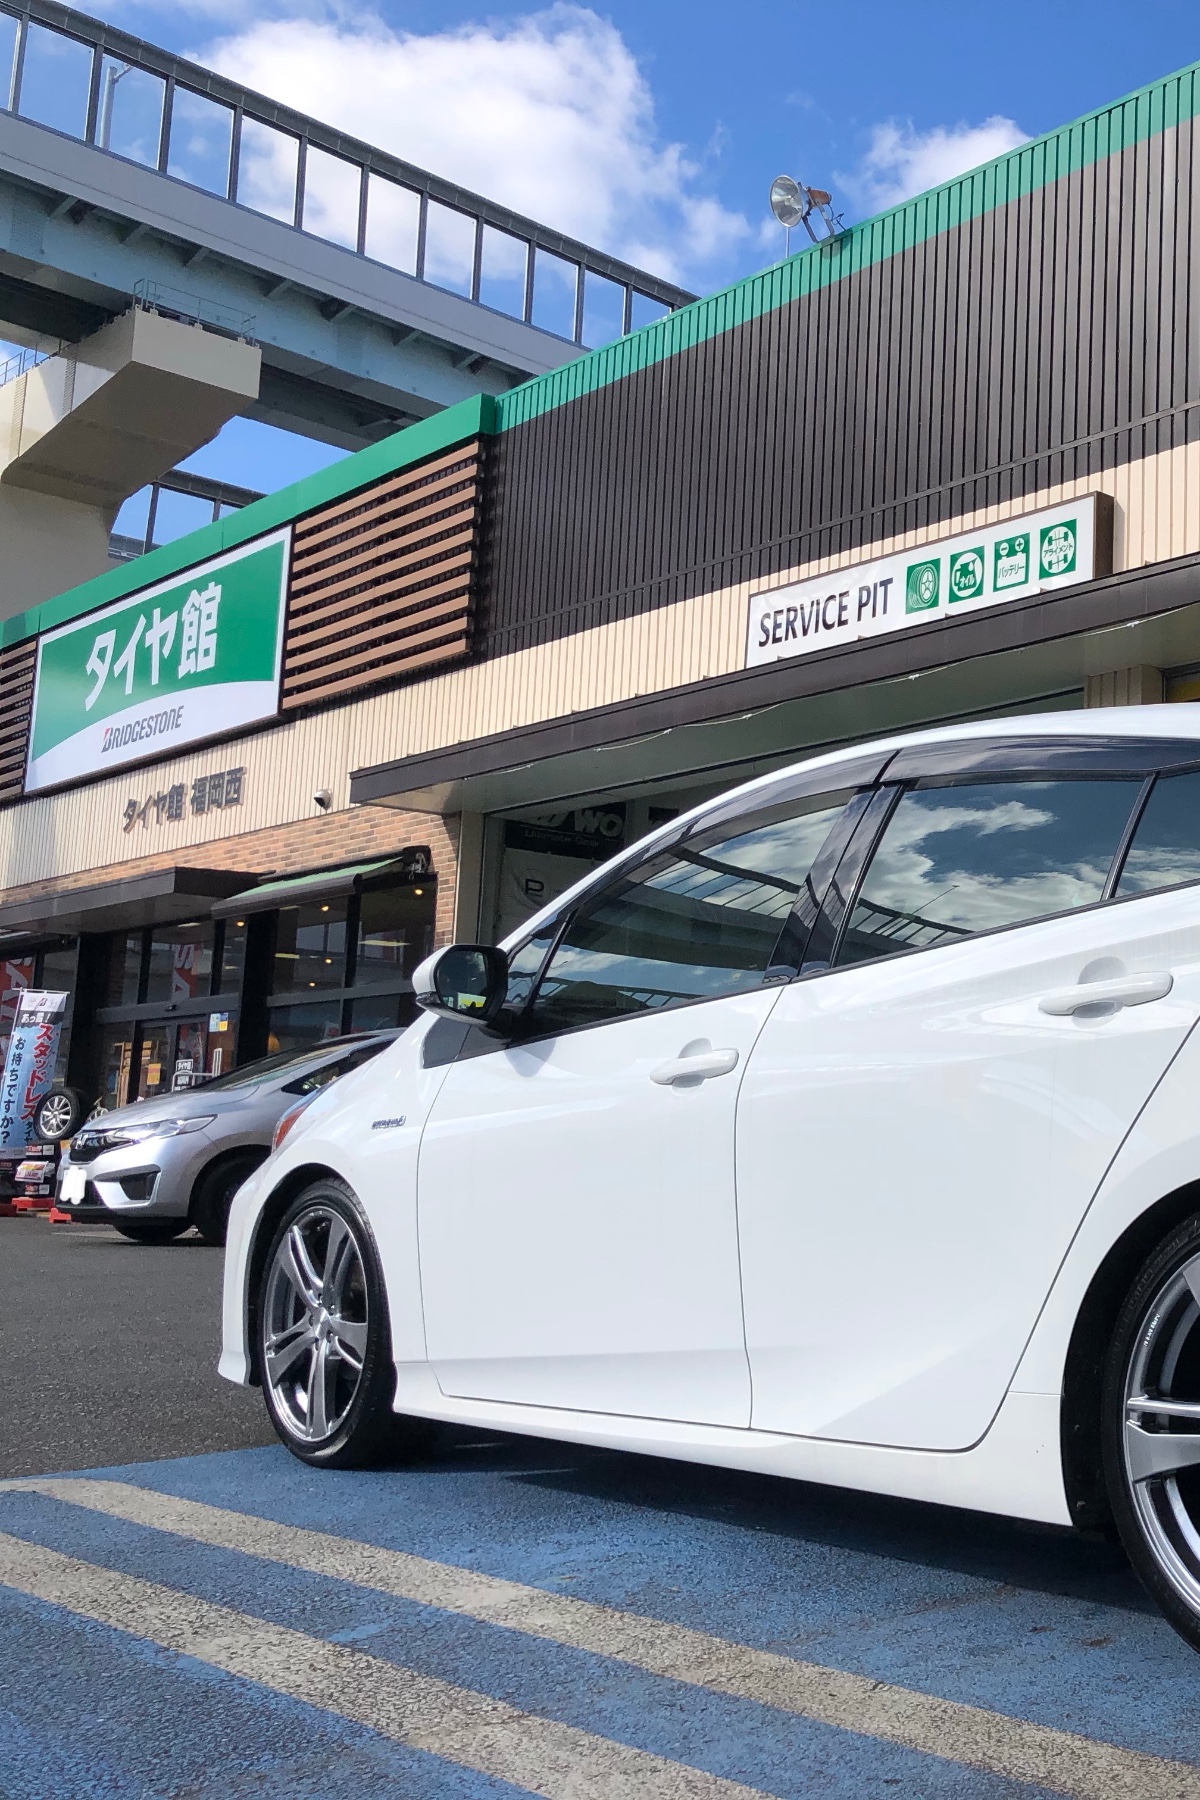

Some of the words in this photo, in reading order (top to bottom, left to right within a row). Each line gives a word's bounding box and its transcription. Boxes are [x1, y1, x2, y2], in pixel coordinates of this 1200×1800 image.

[998, 562, 1025, 578] バッテリー
[1043, 543, 1074, 558] アライメント
[959, 573, 975, 588] オイル
[759, 591, 849, 647] SERVICE
[857, 577, 893, 622] PIT
[85, 582, 222, 712] タイヤ館
[101, 705, 184, 753] BRIDGESTONE
[123, 782, 188, 834] タイヤ館
[191, 766, 247, 817] 福岡西
